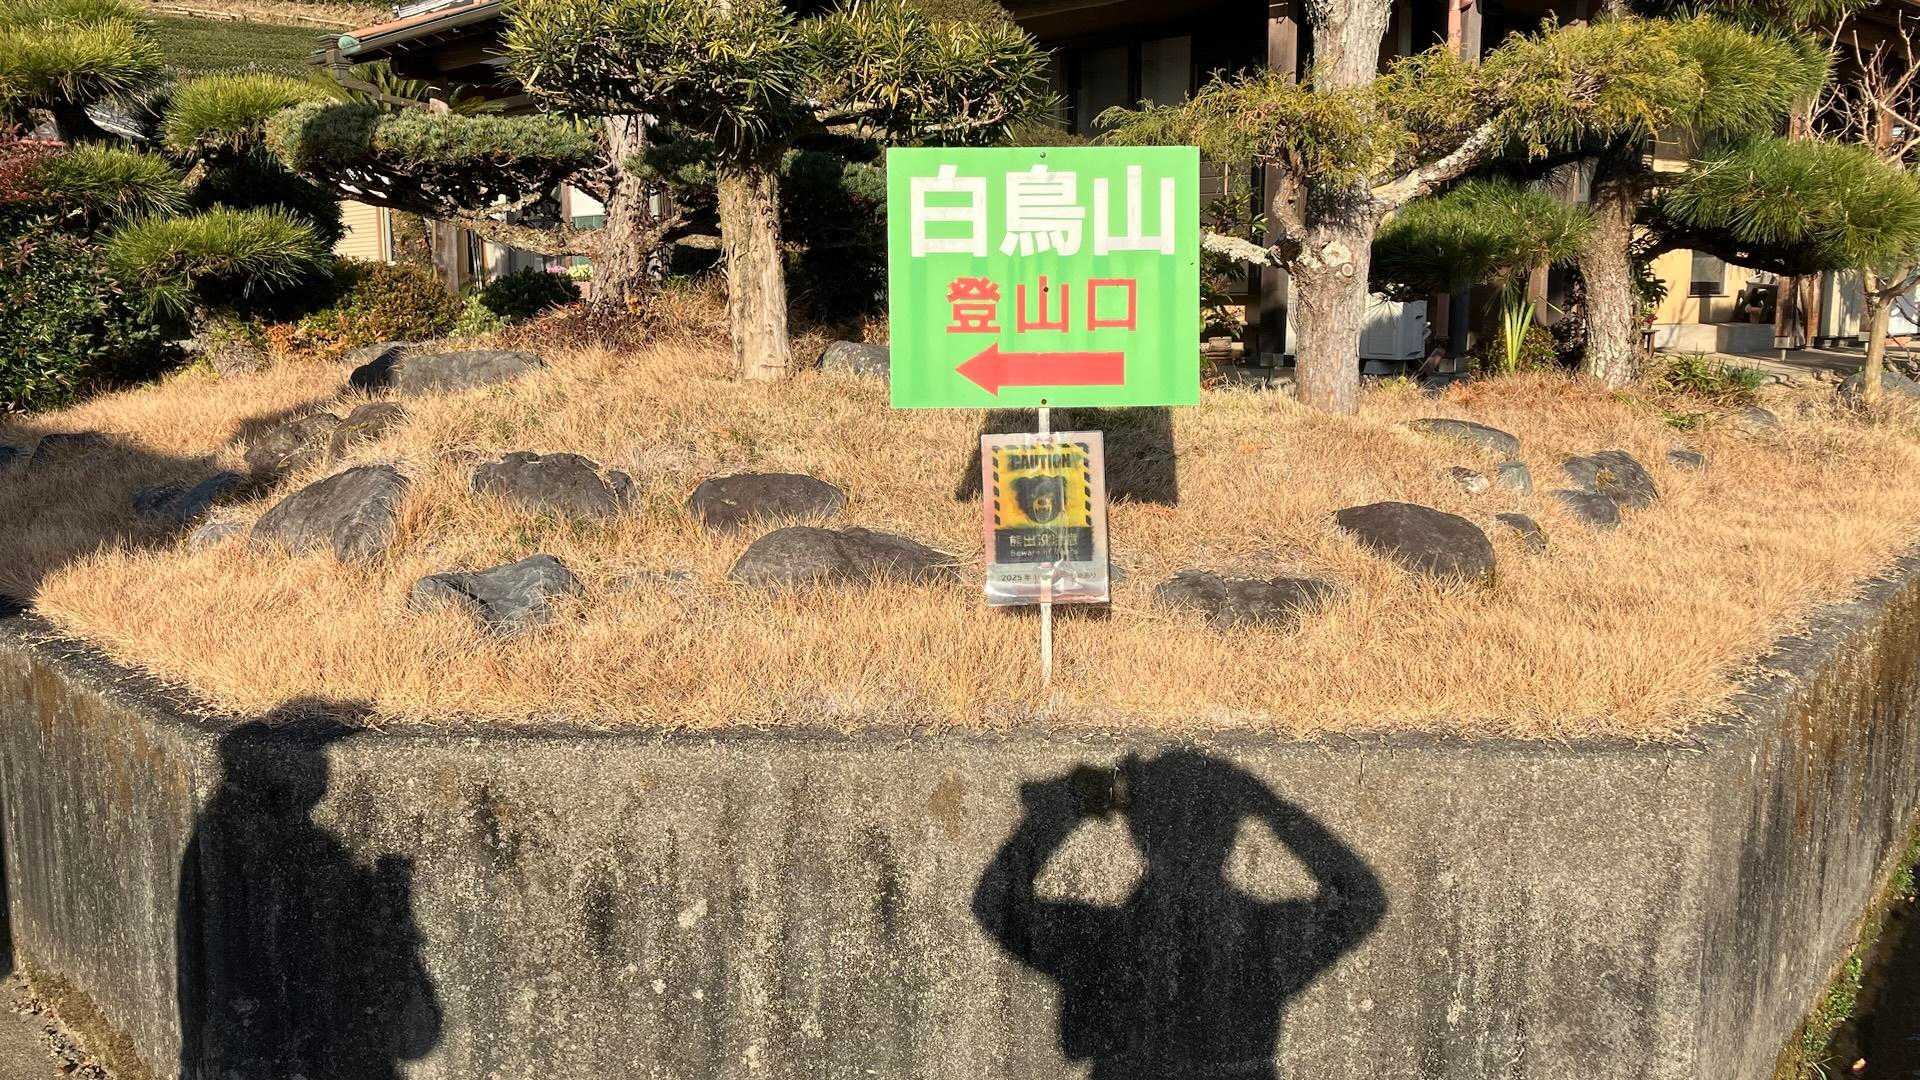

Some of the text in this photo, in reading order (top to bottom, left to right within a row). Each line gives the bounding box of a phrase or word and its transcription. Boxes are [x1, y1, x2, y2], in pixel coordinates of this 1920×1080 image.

[910, 164, 1175, 257] 白鳥山
[946, 276, 1136, 333] 登山口
